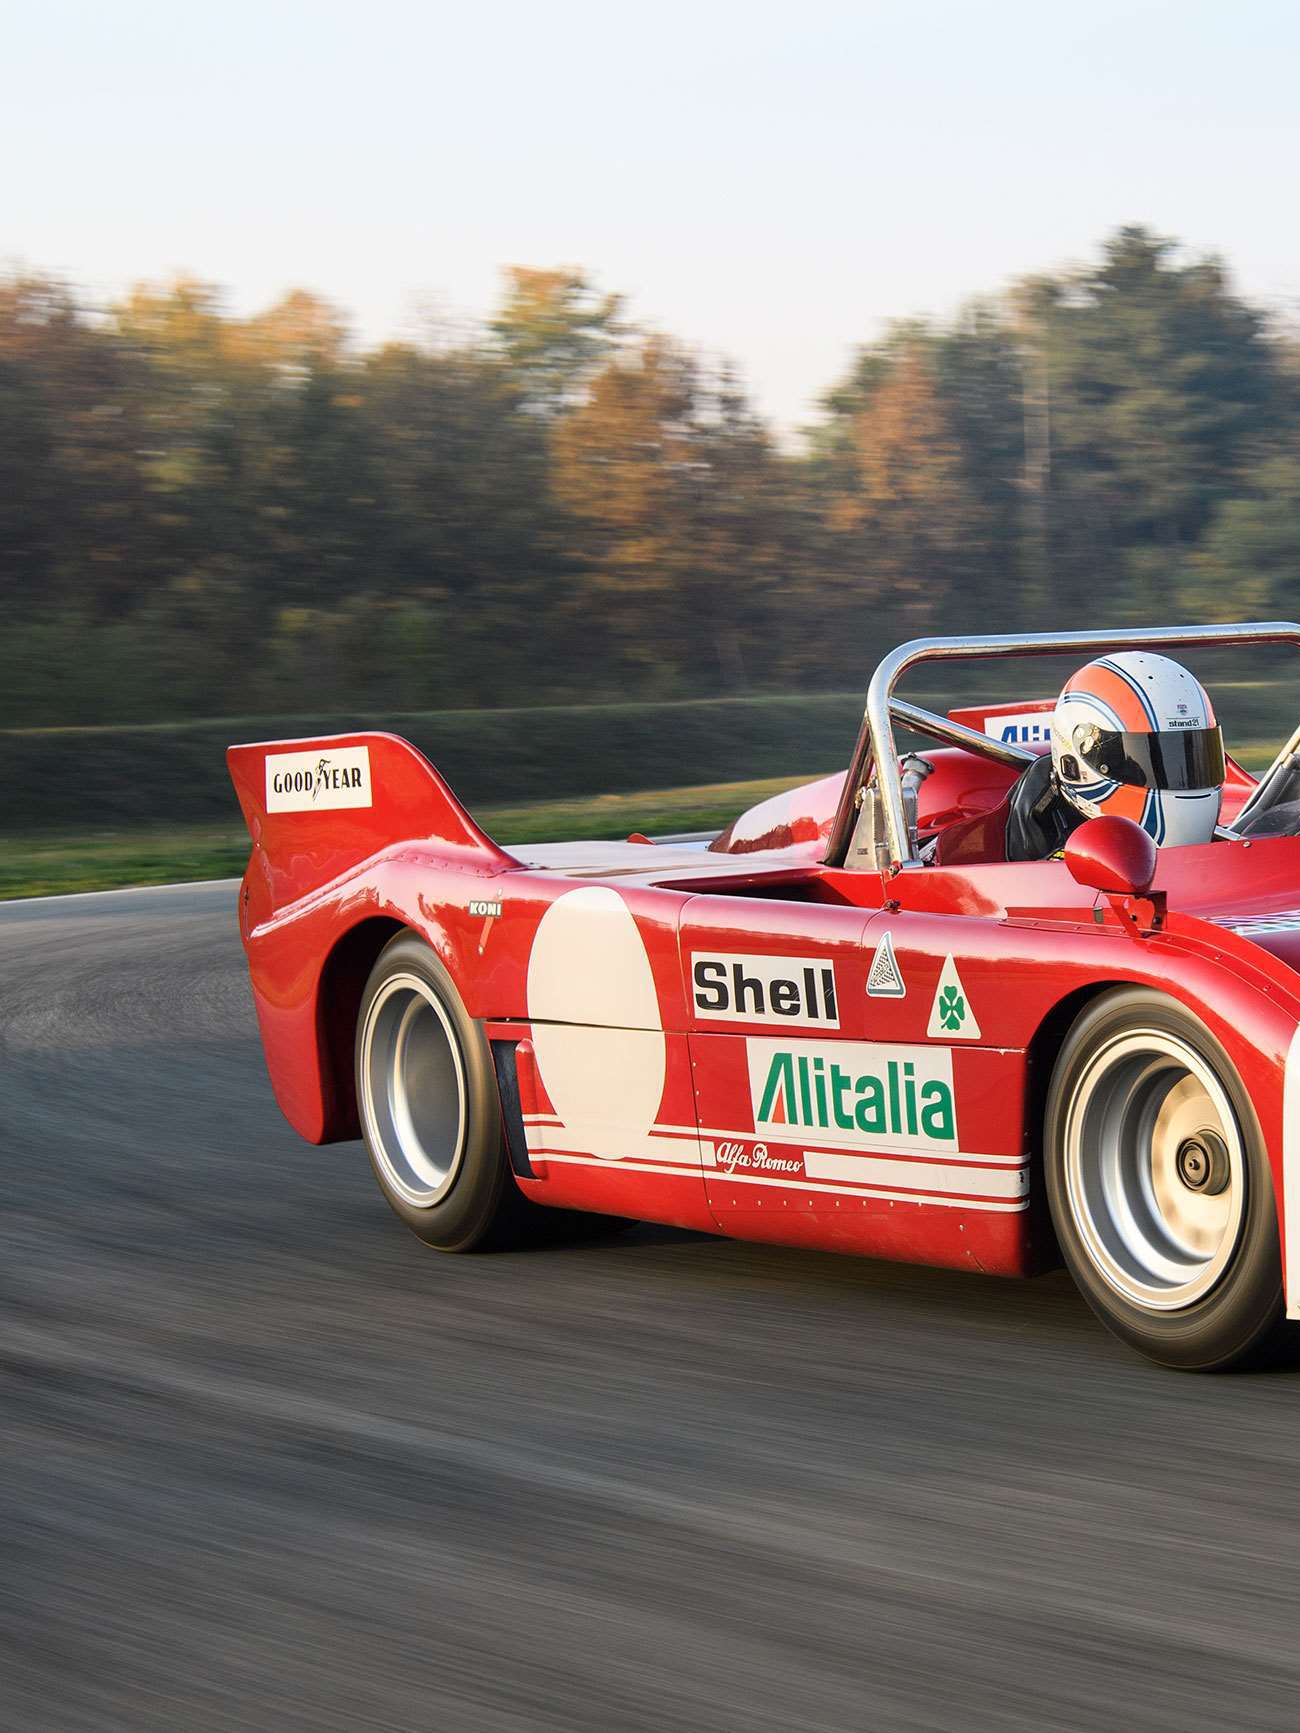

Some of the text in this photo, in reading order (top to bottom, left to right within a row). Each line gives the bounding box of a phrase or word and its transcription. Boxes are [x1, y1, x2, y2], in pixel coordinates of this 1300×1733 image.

[273, 767, 362, 793] GOOD YEAR
[469, 902, 501, 916] KONI
[694, 961, 838, 1020] Shell
[757, 1052, 955, 1140] Alitalia
[717, 1142, 803, 1174] Alfa Romeo
